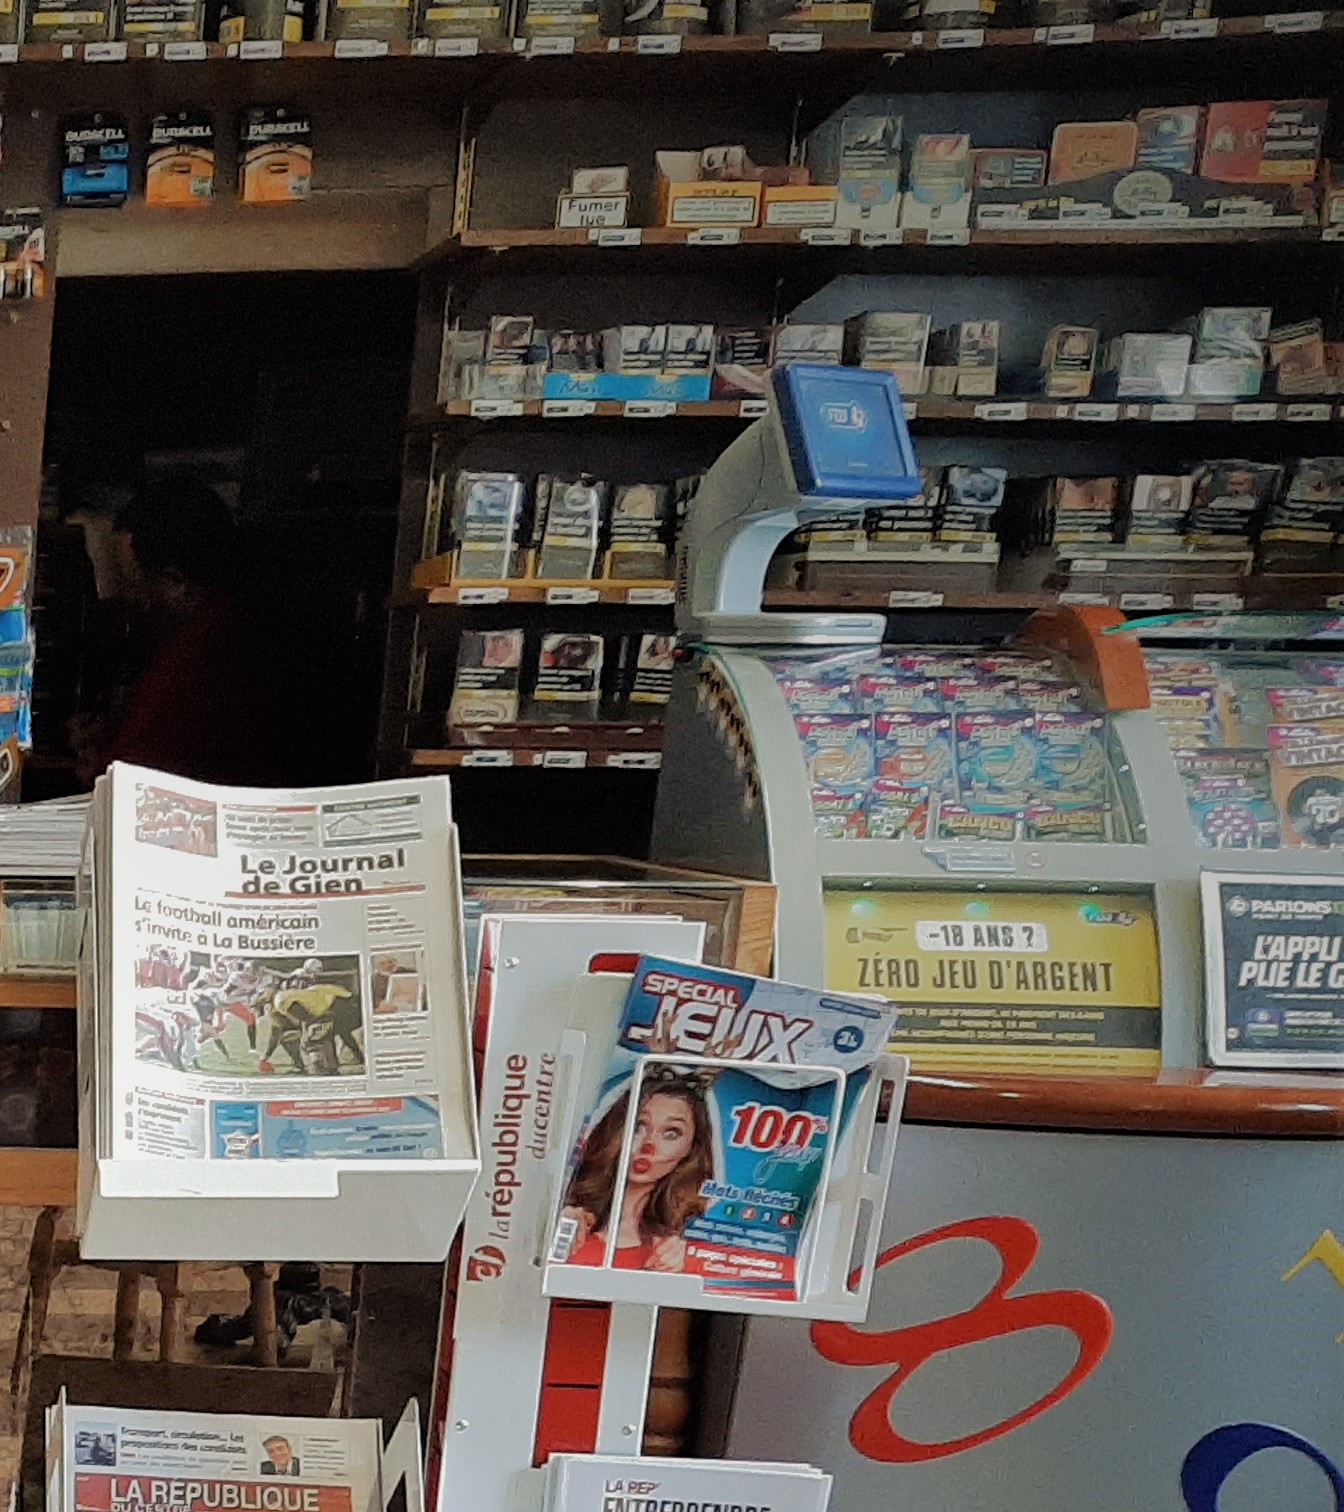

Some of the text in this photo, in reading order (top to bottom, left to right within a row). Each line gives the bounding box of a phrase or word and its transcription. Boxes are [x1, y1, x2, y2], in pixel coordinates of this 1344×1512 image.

[568, 200, 620, 214] Fumer
[240, 847, 406, 876] Le Journal
[241, 874, 364, 895] de Gien
[226, 911, 321, 931] américain
[196, 928, 209, 946] à
[237, 931, 316, 951] Bussière
[928, 924, 1035, 948] -18 ANS ?
[857, 952, 1113, 992] ZÉRO JEU D'ARGENT
[1296, 962, 1325, 988] LE
[643, 973, 739, 1009] SPECIAL
[628, 996, 813, 1066] JEUX
[110, 1477, 320, 1512] LA RÉPUBLIQUE
[604, 1480, 624, 1494] LA
